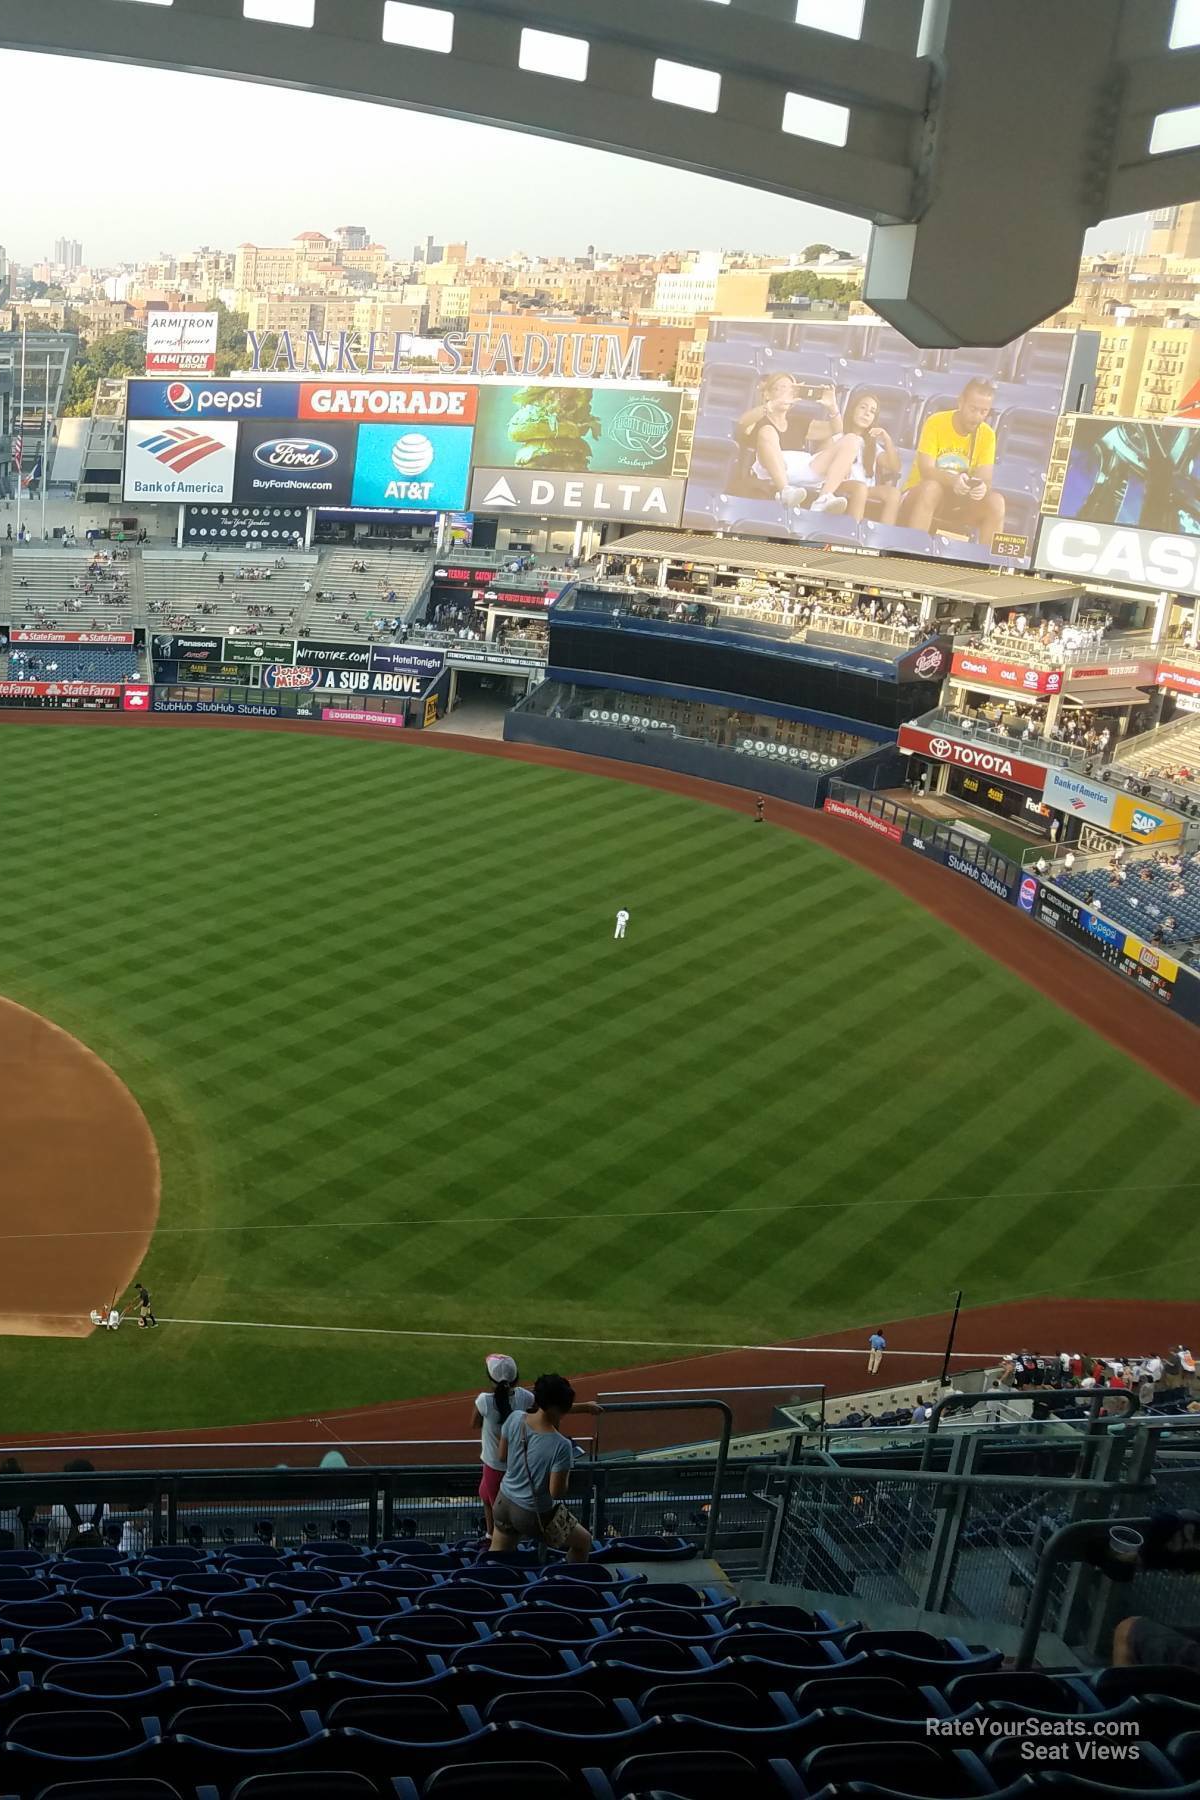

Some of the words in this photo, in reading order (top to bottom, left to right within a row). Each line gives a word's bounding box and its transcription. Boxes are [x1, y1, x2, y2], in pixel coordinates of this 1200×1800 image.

[152, 319, 213, 328] ARMITRON
[152, 354, 208, 364] ARMITRON
[246, 330, 413, 373] YANKEE
[440, 331, 645, 380] STADIUM
[198, 387, 263, 412] pepsi
[311, 390, 467, 415] GATORADE
[269, 443, 322, 466] Ford
[134, 481, 163, 493] Bank
[164, 481, 177, 493] of
[177, 481, 224, 494] America
[253, 479, 333, 491] BuyFordNow.com
[384, 481, 434, 500] AT&T
[530, 480, 668, 514] DELTA
[998, 543, 1020, 555] 6:32
[178, 639, 218, 648] Panasonic
[273, 665, 314, 678] Jersey
[961, 660, 988, 674] Check
[325, 670, 336, 688] A
[339, 671, 370, 690] SUB
[372, 672, 421, 693] ABOVE
[154, 701, 193, 712] StubHub
[196, 702, 235, 714] StubHub
[237, 703, 277, 716] StubHub
[365, 713, 396, 724] DONUTS
[954, 745, 1012, 776] TOYOTA
[1054, 775, 1071, 789] Bank
[1071, 783, 1079, 792] of
[1079, 785, 1108, 804] America
[1025, 796, 1050, 817] FedEx
[1132, 813, 1156, 831] SAP
[948, 855, 980, 881] StubHub
[980, 872, 1008, 898] StubHub
[1040, 888, 1046, 898] G
[1046, 893, 1072, 914] GATORADE
[1072, 908, 1079, 919] G
[1097, 924, 1118, 939] pepsi
